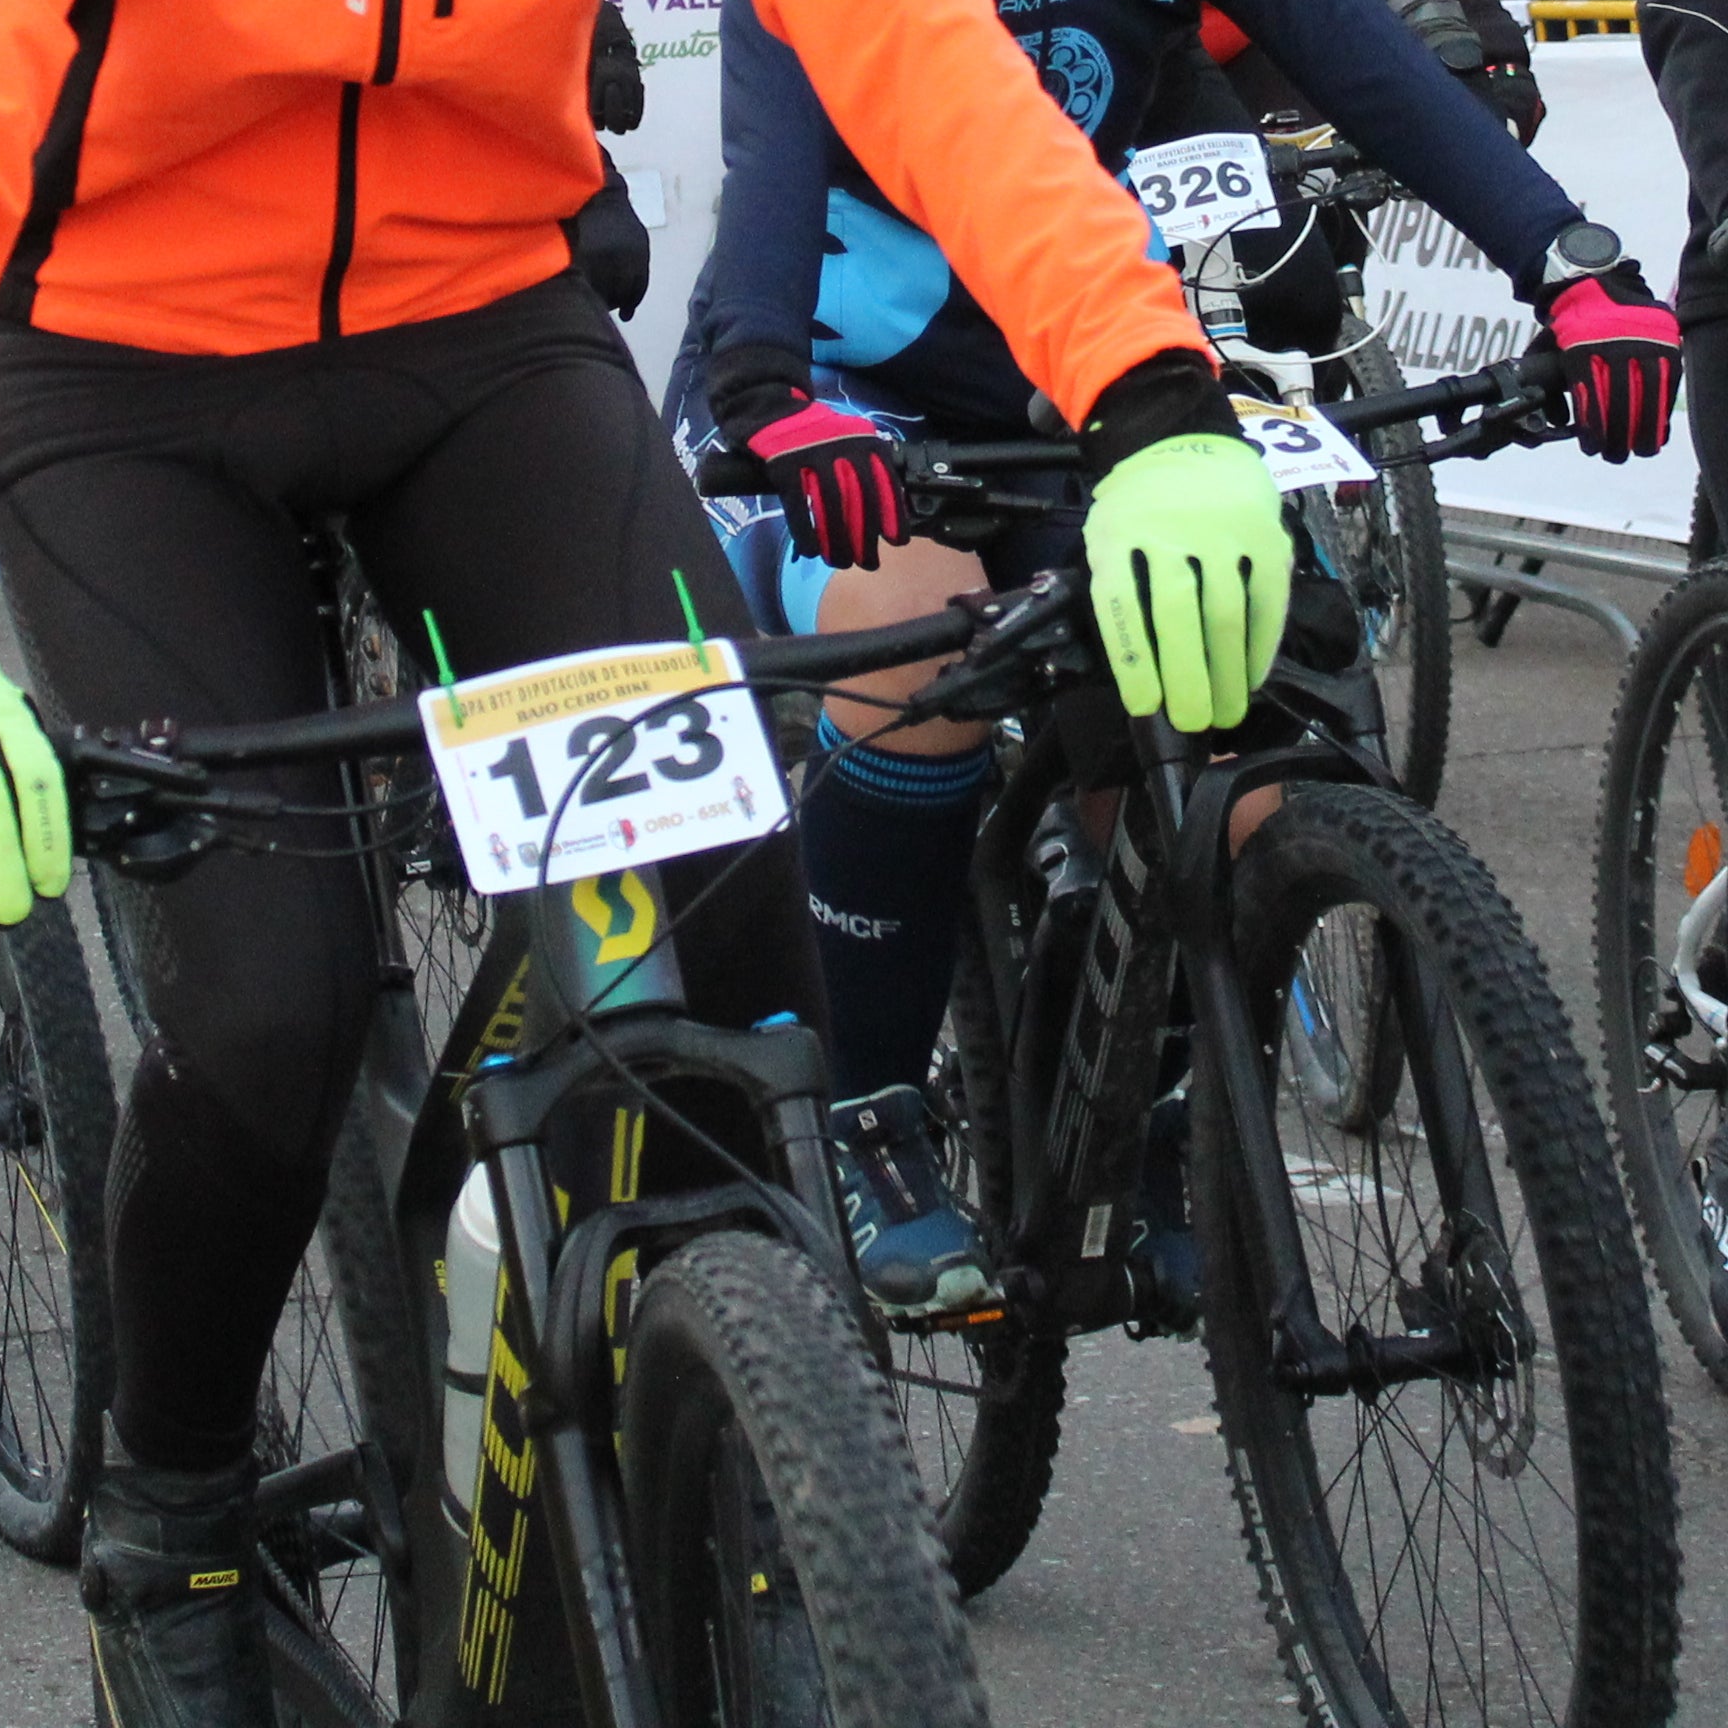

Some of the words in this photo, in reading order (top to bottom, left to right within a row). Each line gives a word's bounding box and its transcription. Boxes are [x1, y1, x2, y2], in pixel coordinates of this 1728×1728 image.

[1139, 160, 1253, 217] 326
[490, 692, 514, 713] BTT
[518, 671, 596, 702] DIPUTACIÓN
[598, 664, 619, 682] DE
[622, 652, 701, 677] VALLADOLID
[516, 702, 560, 723] BAJO
[563, 688, 611, 711] CERO
[614, 680, 651, 698] BIKE
[487, 697, 725, 820] 123
[644, 812, 685, 834] ORO
[808, 891, 902, 941] RMCF
[192, 1572, 236, 1586] MAVIC
